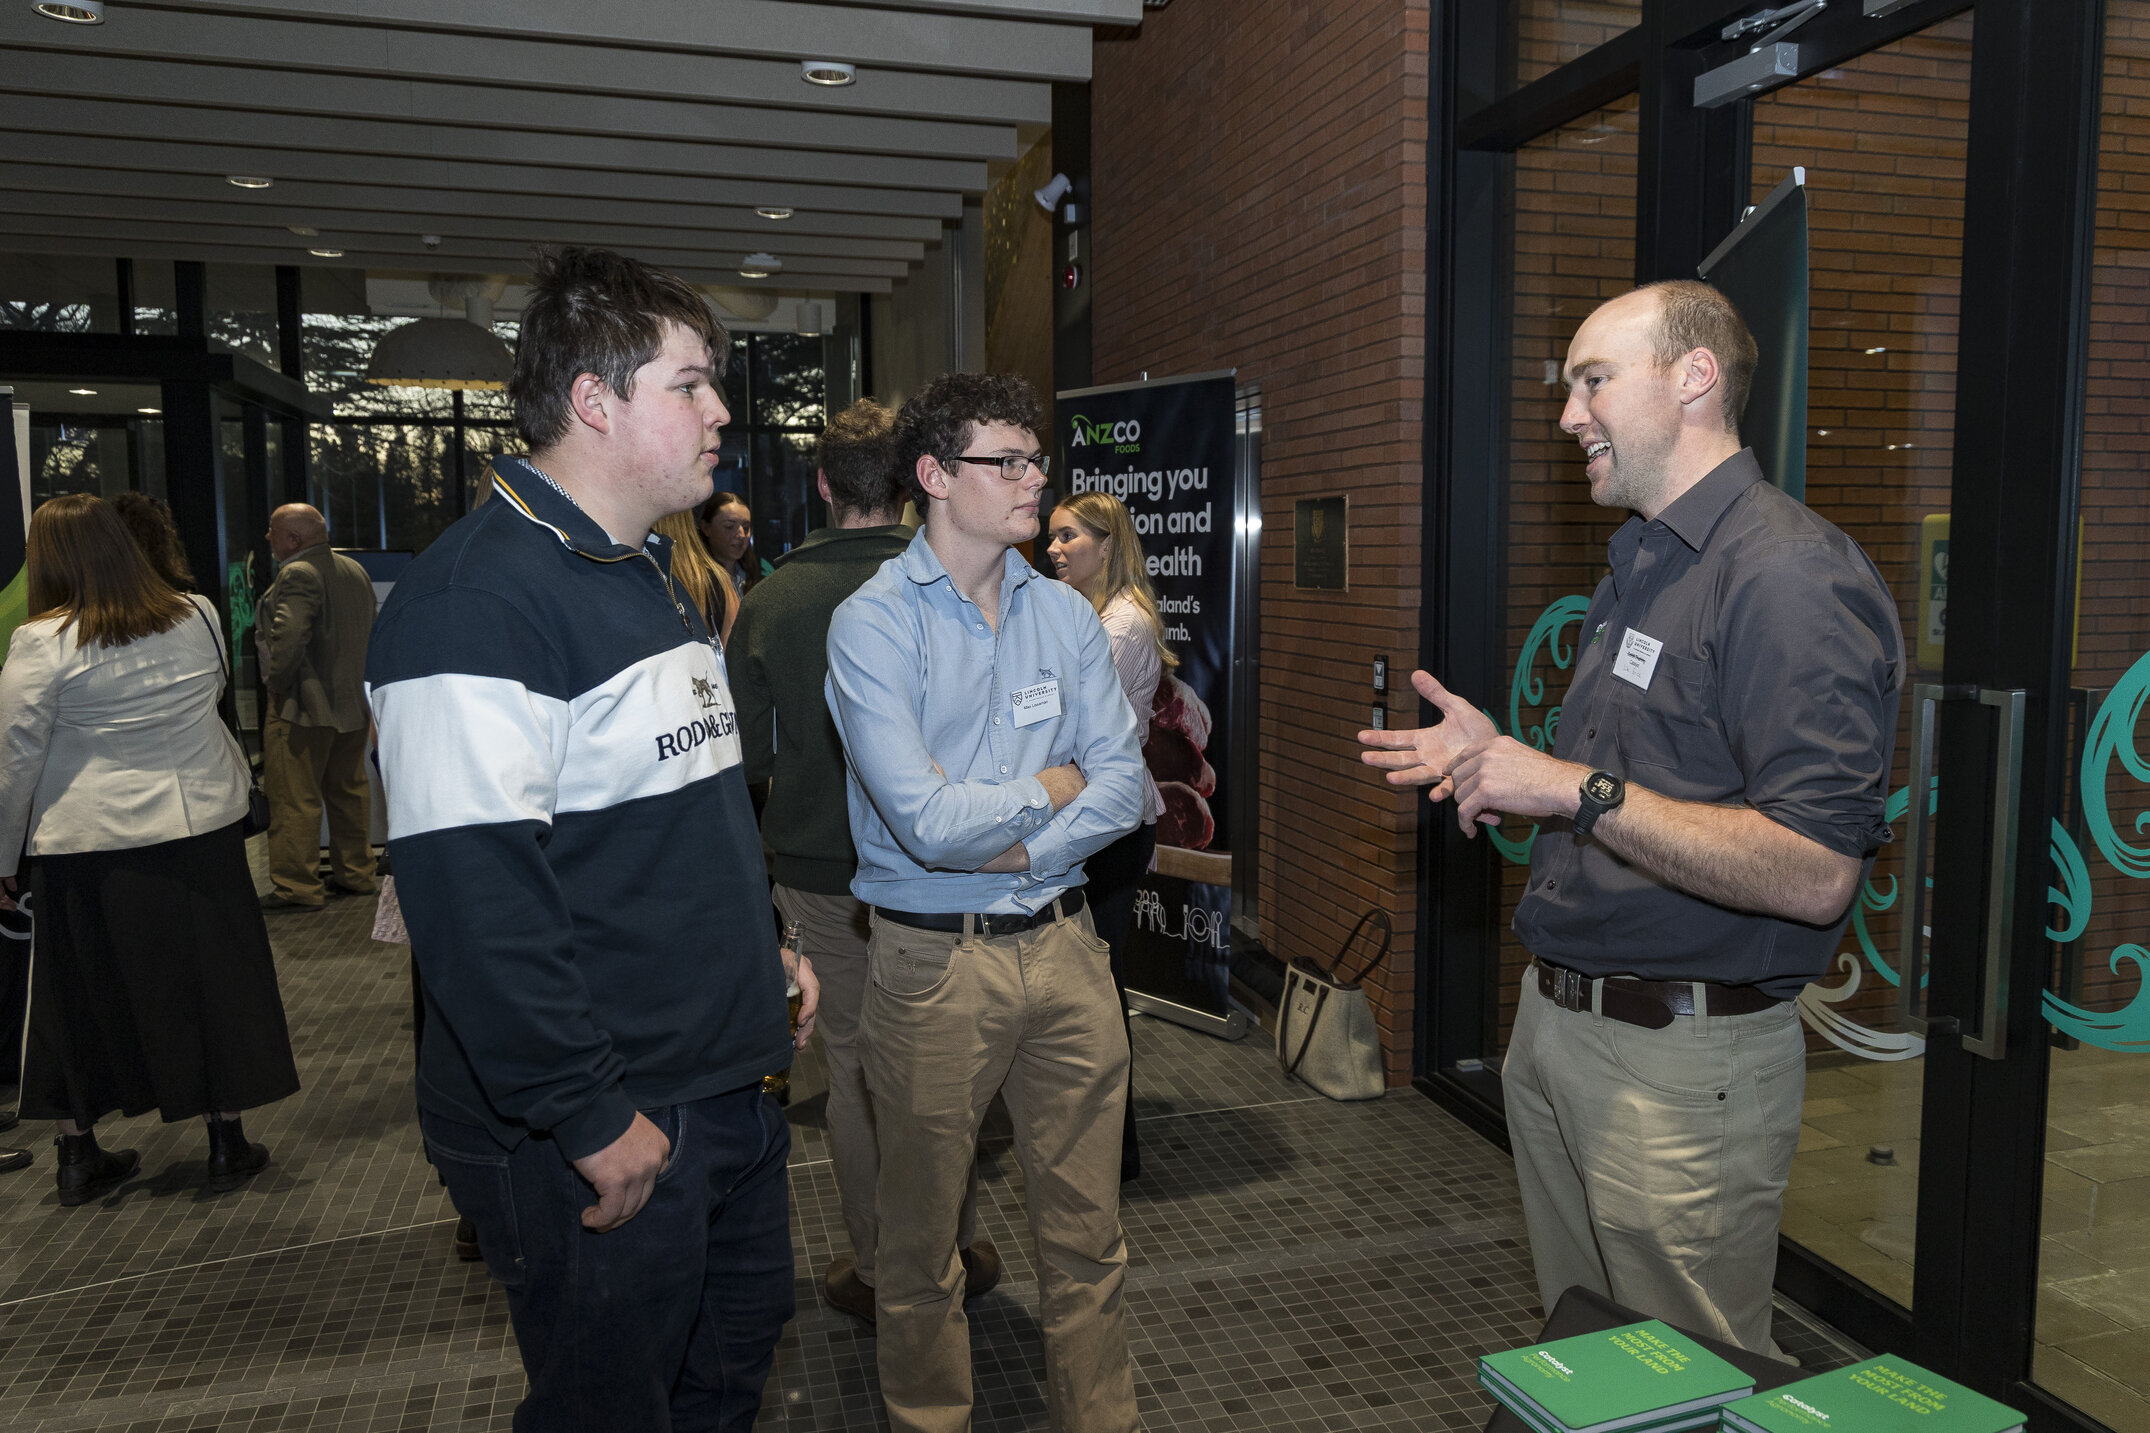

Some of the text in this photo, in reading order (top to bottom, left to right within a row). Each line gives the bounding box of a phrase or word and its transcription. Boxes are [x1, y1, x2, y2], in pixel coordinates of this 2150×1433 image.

[1072, 420, 1141, 447] ANZCO
[1114, 443, 1140, 454] FOODS
[1072, 465, 1208, 503] Bringing you
[1129, 502, 1212, 535] ion and
[1146, 545, 1202, 577] ealth
[1157, 594, 1201, 614] aland's
[1024, 685, 1047, 695] LINCOLN
[1025, 687, 1057, 699] UNIVERSITY
[1608, 1335, 1669, 1375] YOUR LAND
[1621, 1332, 1685, 1372] MOST FROM
[1635, 1329, 1692, 1363] MAKE THE
[1538, 1350, 1574, 1375] Catalyst
[1850, 1373, 1930, 1415] YOUR LAND
[1860, 1369, 1946, 1412] MOST FROM
[1873, 1365, 1948, 1401] MAKE THE
[1782, 1394, 1829, 1420] Catalyst
